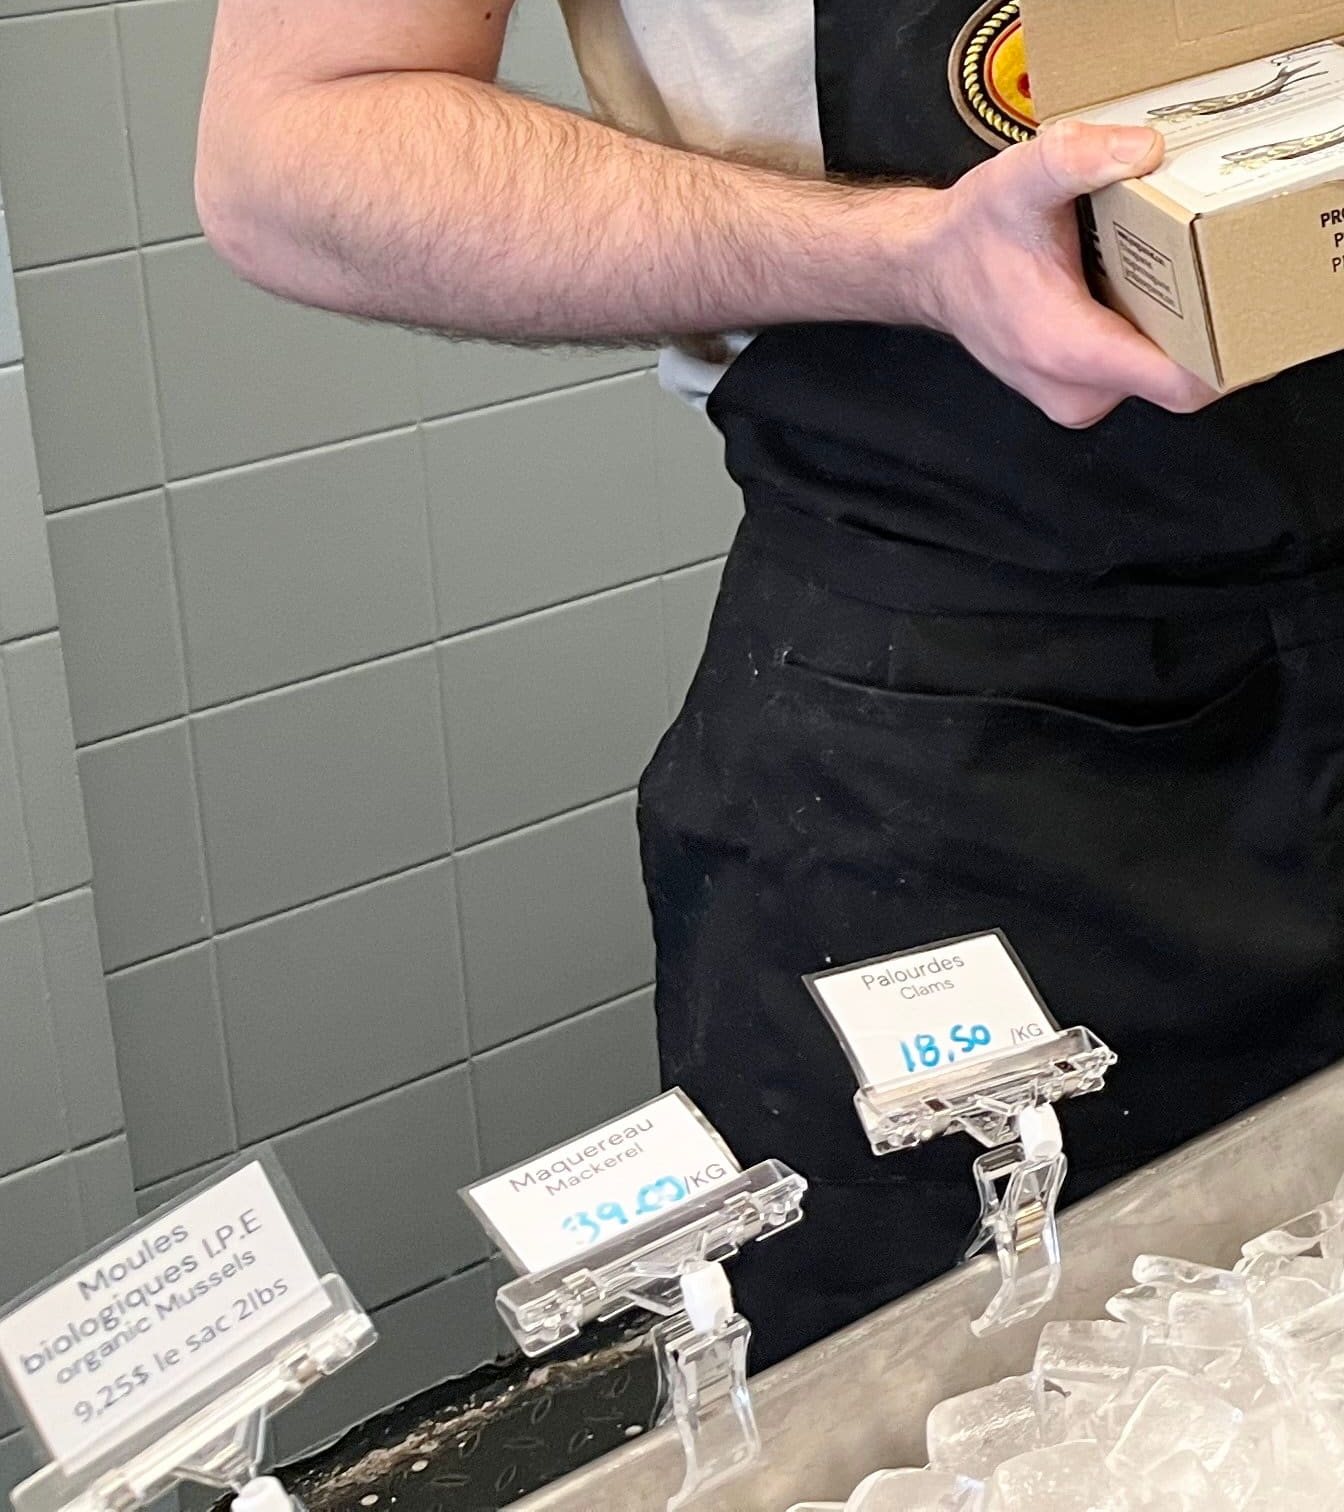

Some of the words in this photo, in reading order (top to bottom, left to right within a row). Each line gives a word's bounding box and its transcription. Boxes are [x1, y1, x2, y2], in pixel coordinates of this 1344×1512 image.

[861, 951, 966, 992] Palourdes
[899, 974, 956, 1002] Clams
[1009, 1020, 1045, 1047] /KG
[507, 1114, 655, 1194] Maquereau
[544, 1141, 646, 1198] Mackerel
[76, 1223, 190, 1302] Moules
[21, 1254, 200, 1375] biologiques
[55, 1315, 152, 1385] organic
[154, 1248, 257, 1321] Mussels
[152, 1347, 181, 1372] le
[184, 1314, 233, 1353] sac
[231, 1277, 289, 1322] 2lbs
